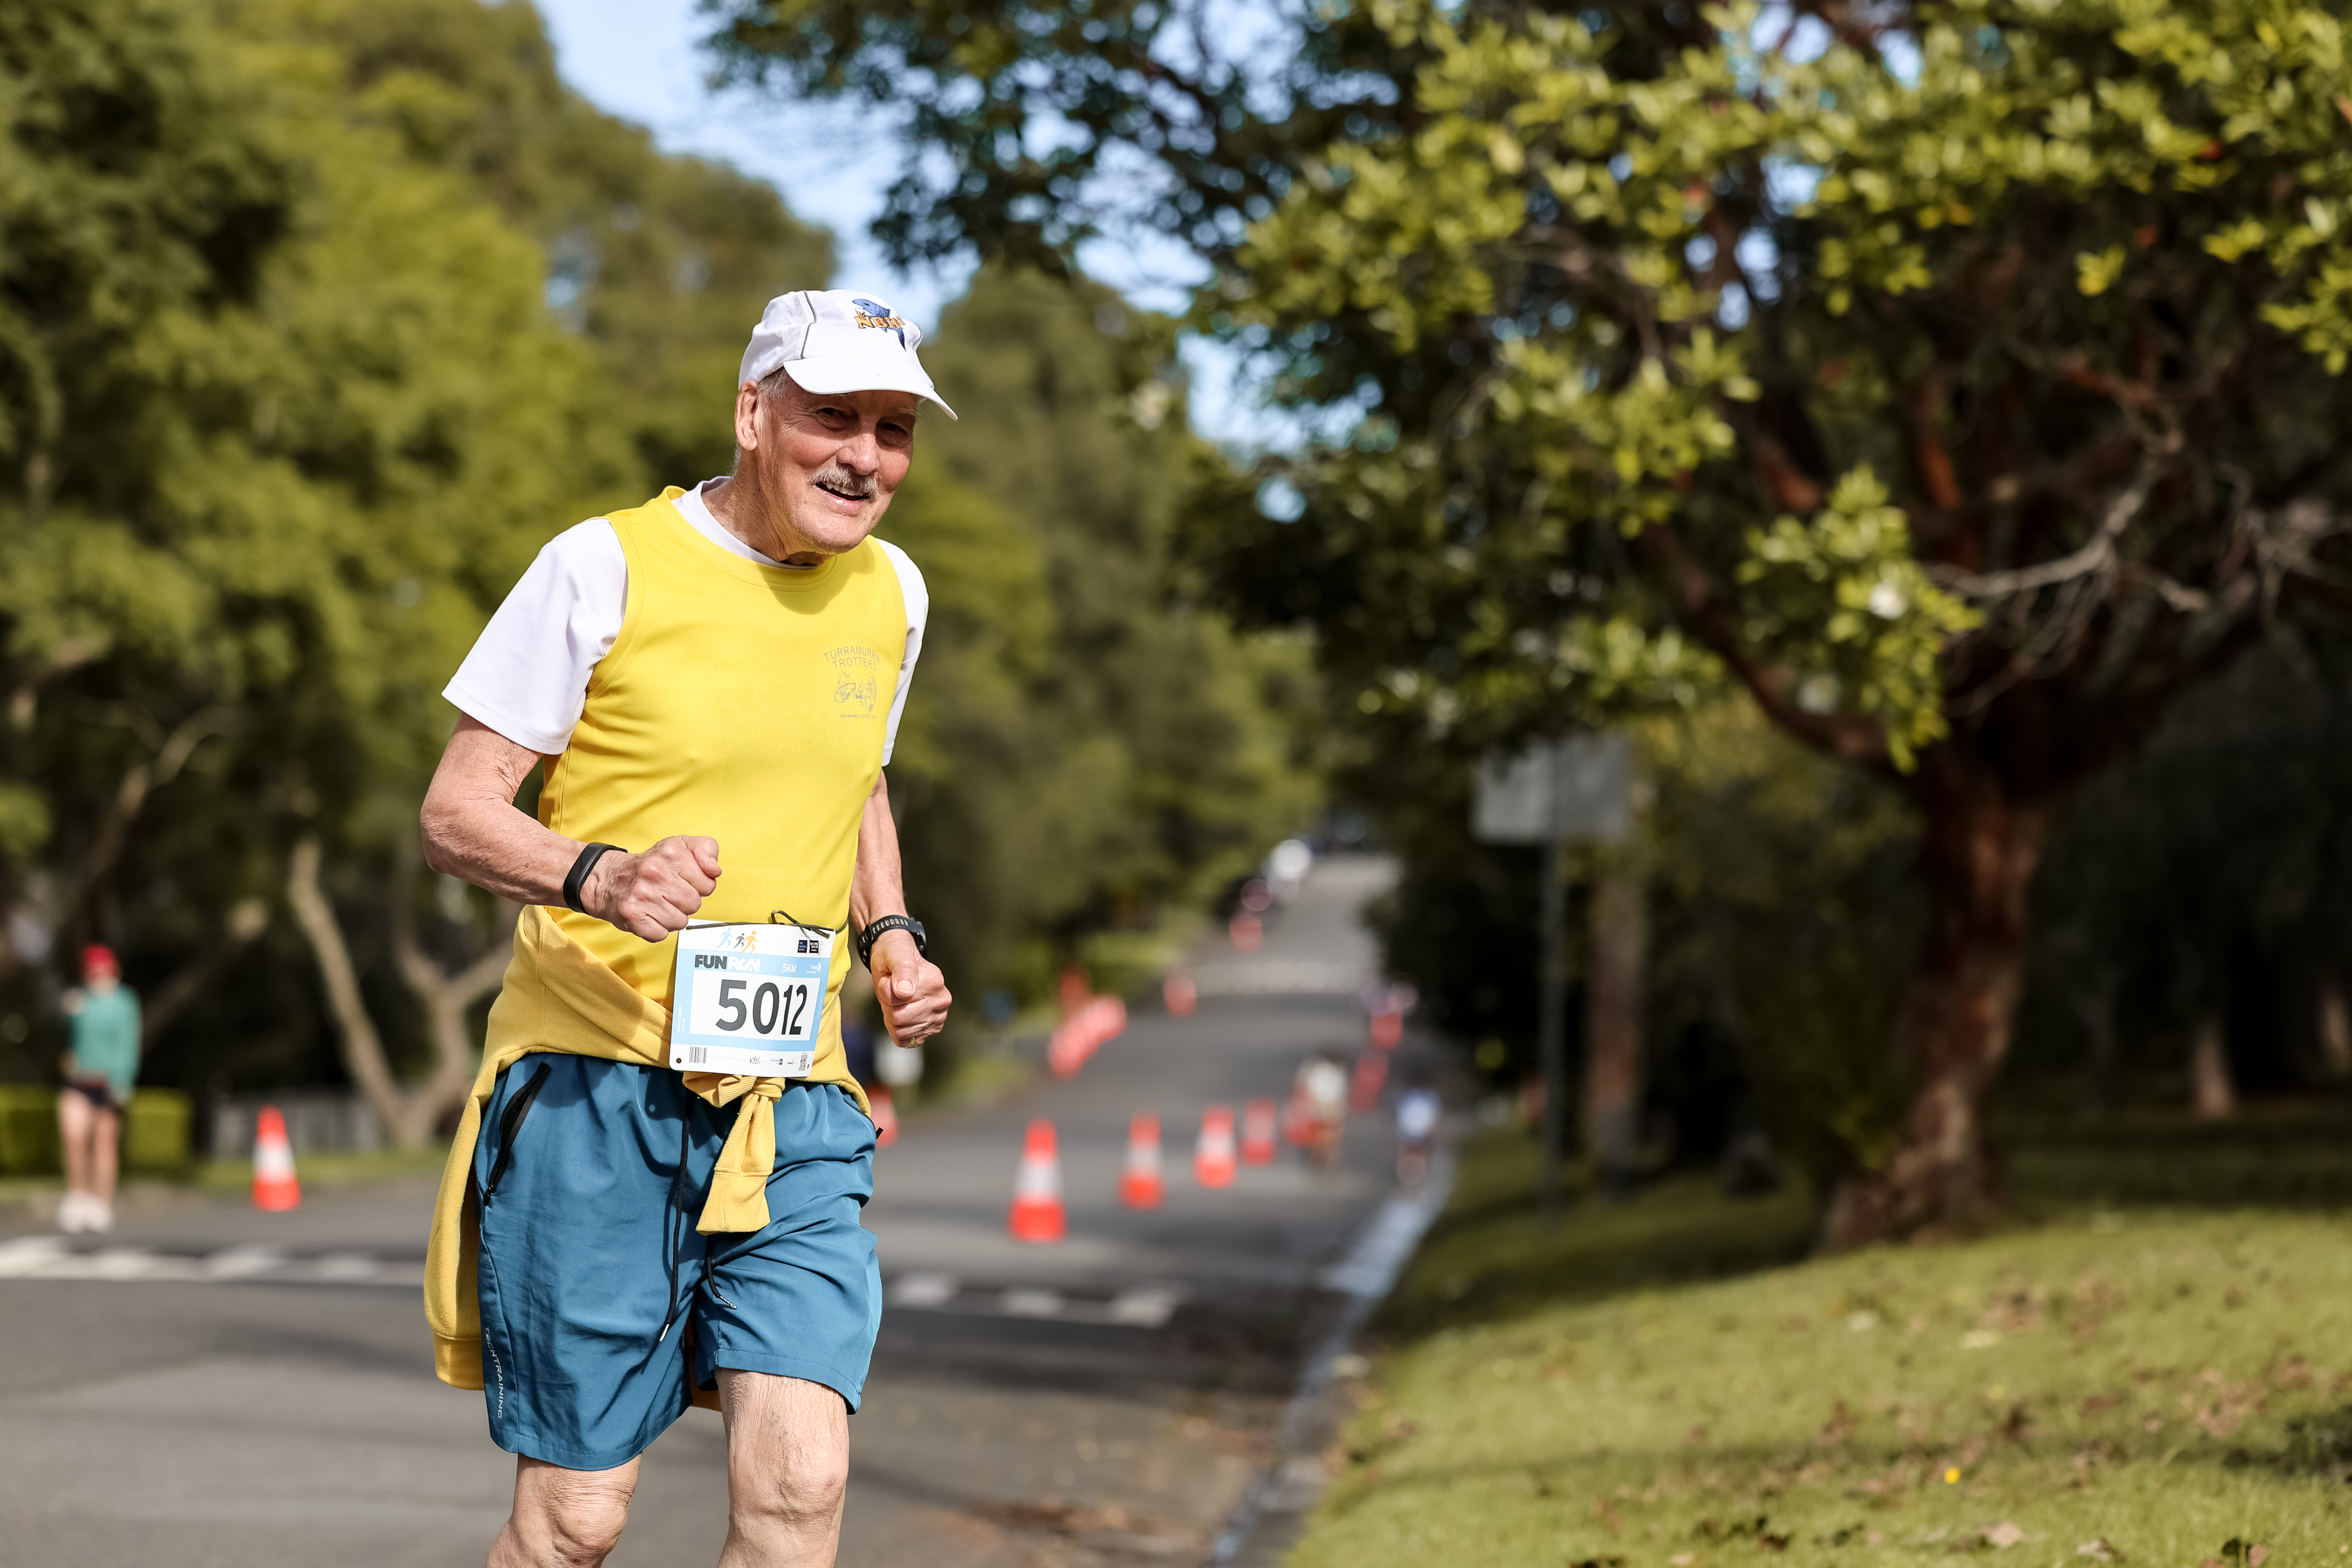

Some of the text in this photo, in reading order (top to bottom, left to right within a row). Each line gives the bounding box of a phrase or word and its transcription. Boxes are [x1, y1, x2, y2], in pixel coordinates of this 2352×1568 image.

[823, 646, 880, 664] TURRAMURRA
[832, 657, 876, 671] TROTTERS
[695, 955, 761, 973] FUN RUN
[782, 963, 797, 973] 5KM
[715, 979, 807, 1035] 5012
